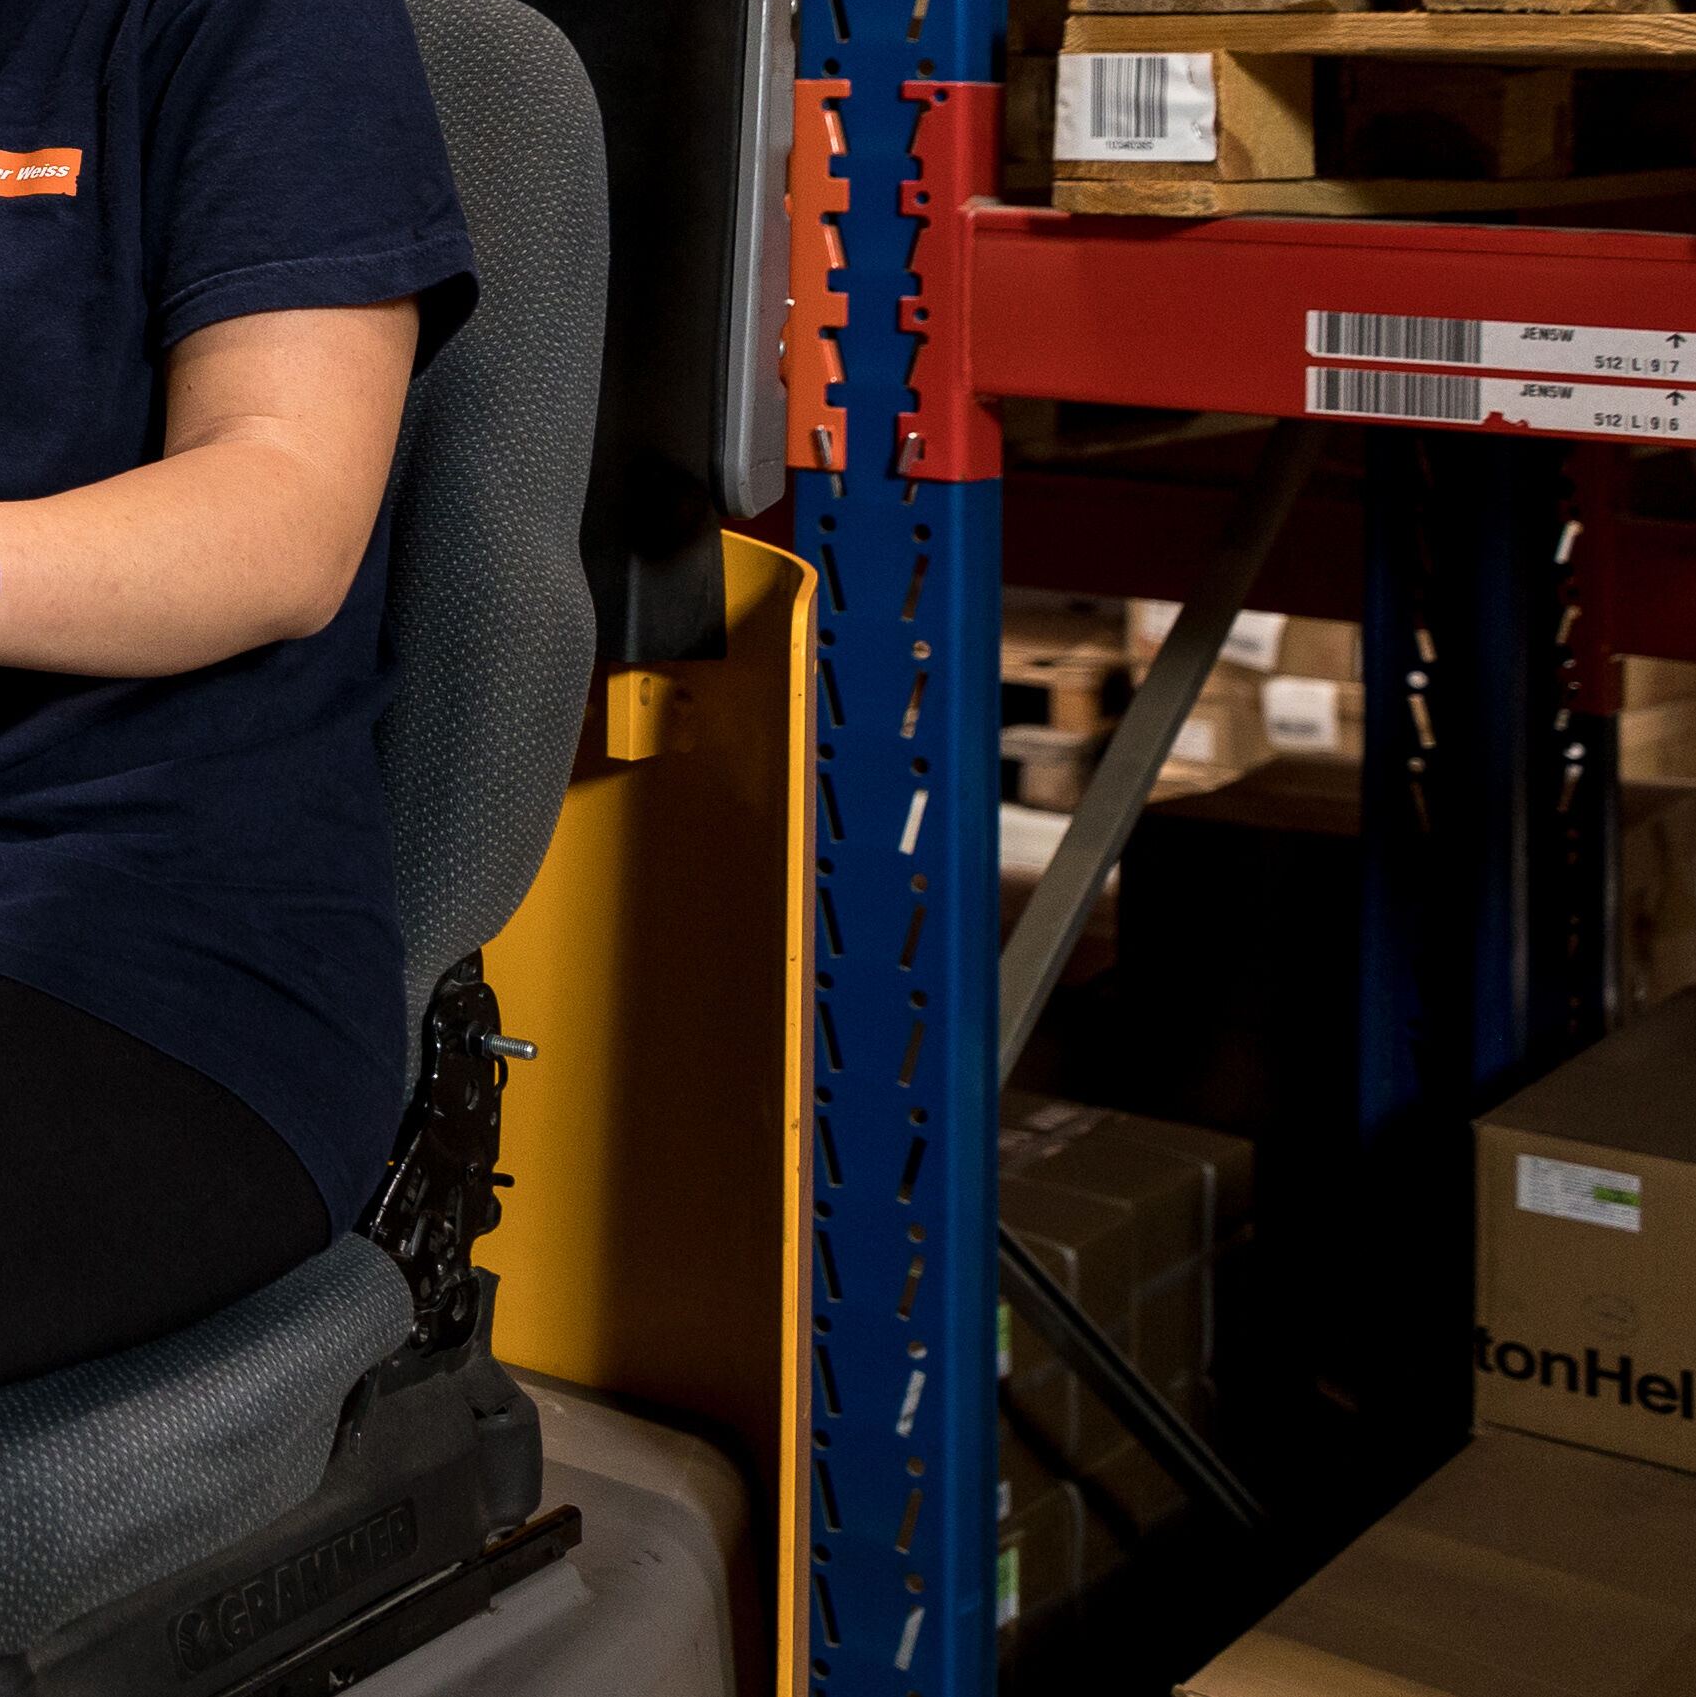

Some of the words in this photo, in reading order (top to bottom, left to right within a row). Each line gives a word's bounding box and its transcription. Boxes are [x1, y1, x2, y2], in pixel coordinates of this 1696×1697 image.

[16, 163, 70, 180] Weiss
[1520, 327, 1574, 341] JENSW
[1594, 355, 1623, 370] 512
[1631, 357, 1642, 372] L
[1650, 359, 1661, 373] 9
[1669, 360, 1680, 374] 7
[1520, 384, 1573, 398] JENSW
[1593, 412, 1623, 428] 512
[1631, 414, 1642, 429] L
[1650, 416, 1661, 430] 9
